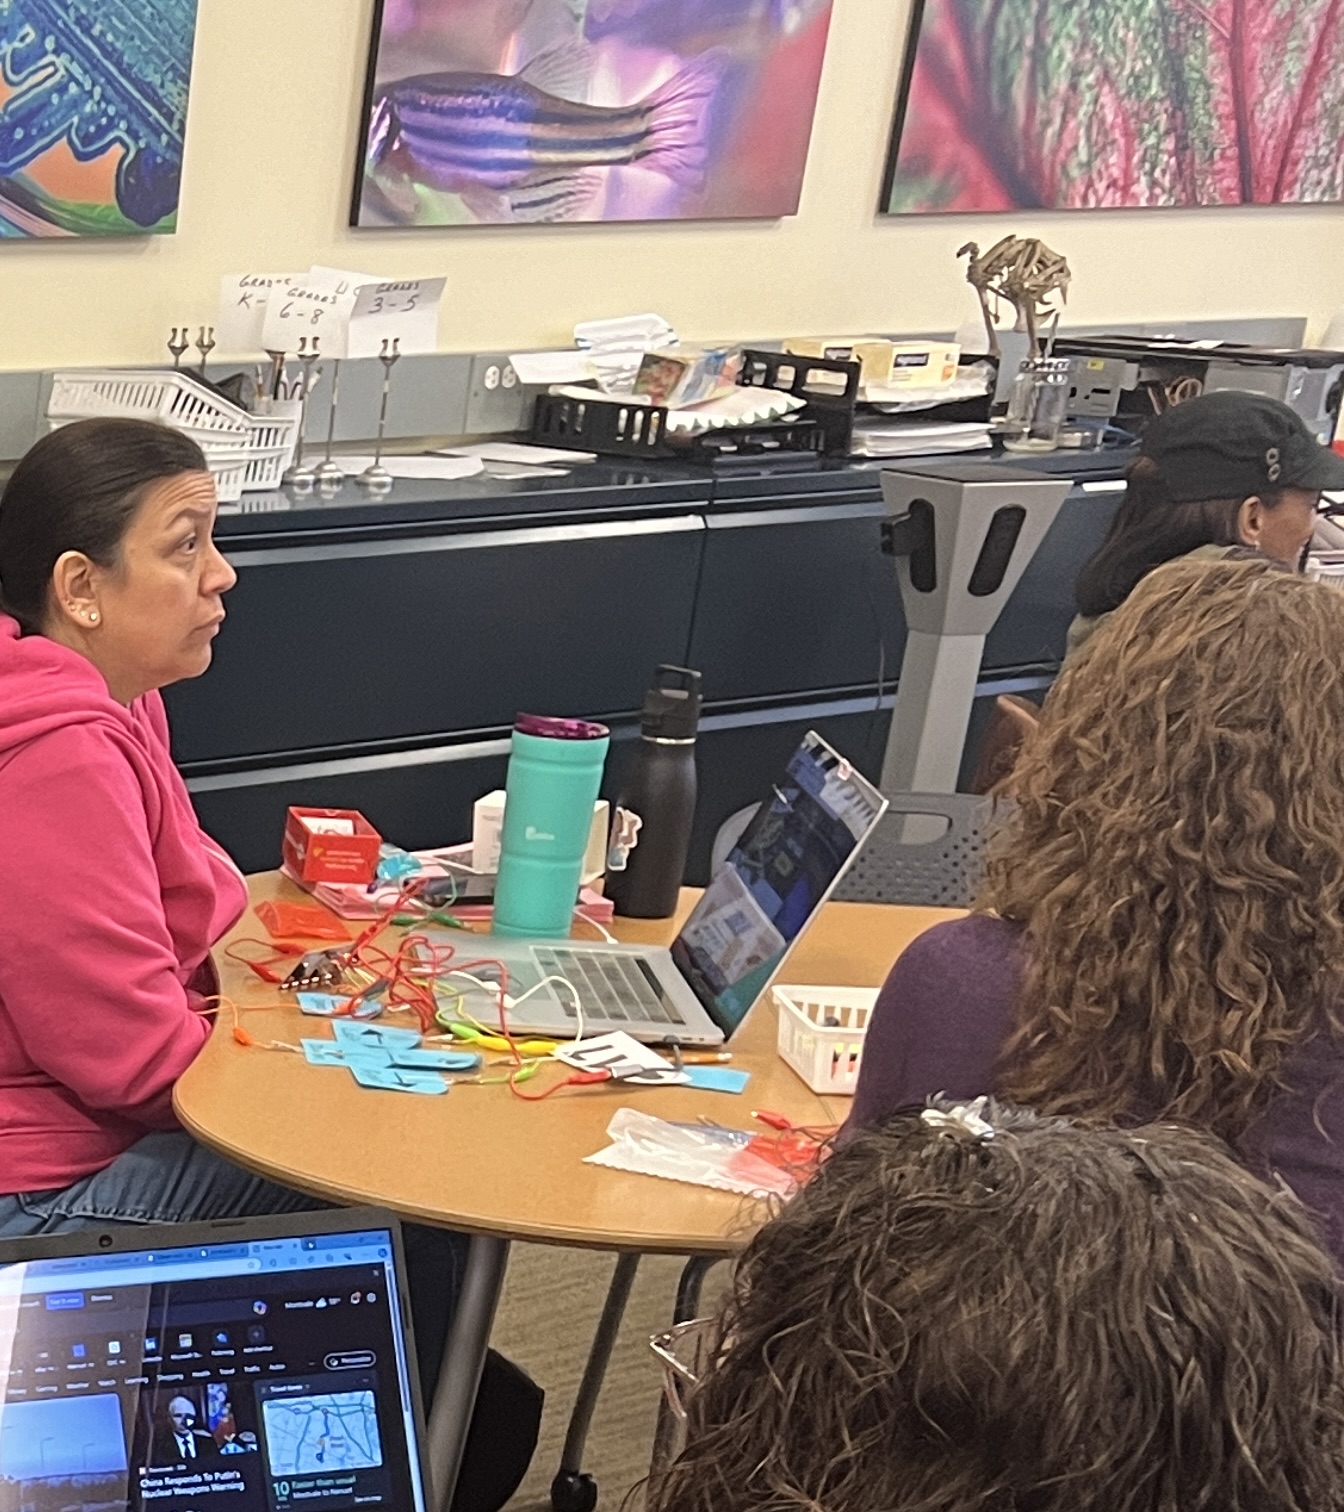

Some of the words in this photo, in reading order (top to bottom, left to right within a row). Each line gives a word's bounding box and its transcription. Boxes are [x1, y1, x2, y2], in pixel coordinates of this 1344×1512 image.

[140, 1479, 163, 1488] China
[164, 1473, 202, 1486] Responds
[214, 1471, 241, 1481] Putin's
[141, 1488, 172, 1498] Nuclear
[173, 1486, 210, 1496] Weapons
[210, 1482, 245, 1492] Warning
[273, 1481, 290, 1496] 10
